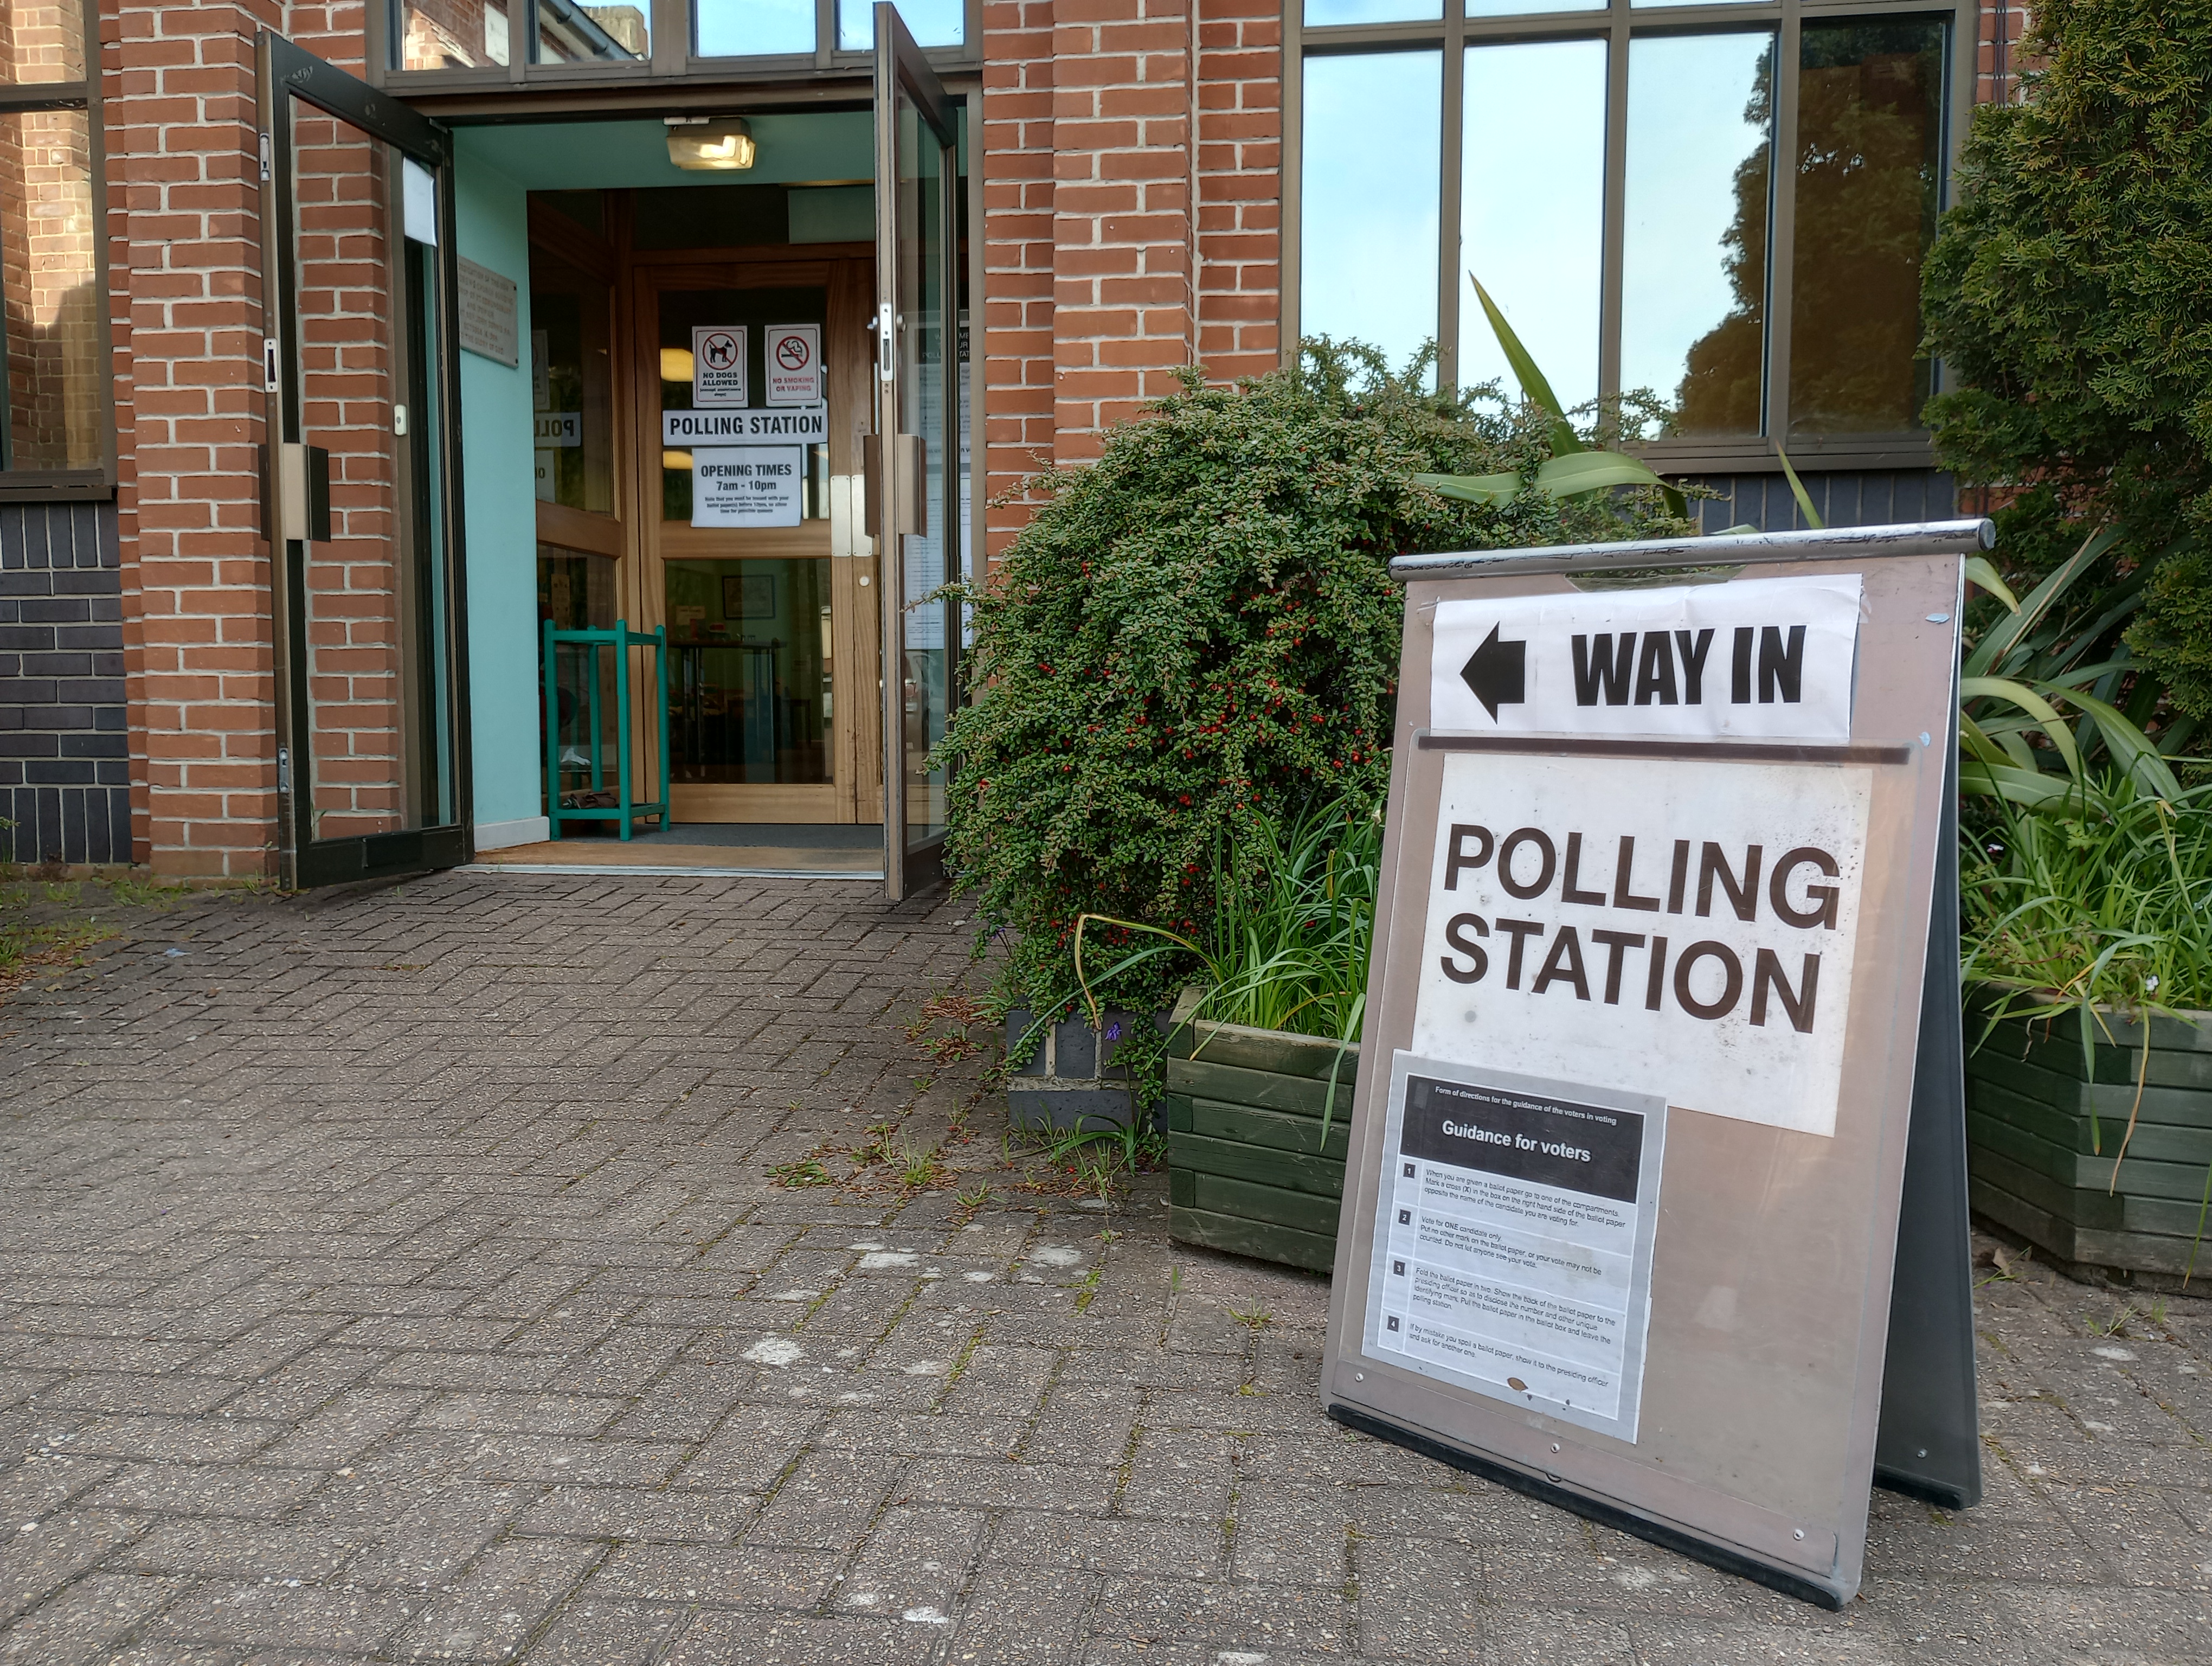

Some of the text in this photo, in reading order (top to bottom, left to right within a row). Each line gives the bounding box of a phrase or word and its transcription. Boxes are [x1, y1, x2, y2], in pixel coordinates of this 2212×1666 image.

[670, 415, 822, 435] POLLING STATION
[701, 464, 792, 477] OPENING TIMES
[716, 480, 738, 491] 7am
[748, 480, 776, 492] 10pm
[1571, 624, 1806, 707] WAY IN
[1443, 823, 1841, 931] POLLING
[1440, 913, 1821, 1034] STATION
[1435, 1086, 1451, 1094] Form
[1459, 1091, 1490, 1101] directions
[1513, 1101, 1542, 1111] guidance
[1564, 1110, 1585, 1118] voters
[1594, 1116, 1616, 1125] voting
[1442, 1120, 1590, 1162] Guidance for voters
[1425, 1177, 1439, 1186] Mark
[1462, 1186, 1471, 1194] (X)
[1490, 1191, 1501, 1200] box
[1536, 1202, 1552, 1211] hand
[1587, 1213, 1604, 1223] ballot
[1605, 1219, 1625, 1227] paper
[1489, 1182, 1505, 1191] ballot
[1401, 1213, 1407, 1221] 2
[1422, 1215, 1435, 1224] Vote
[1444, 1221, 1458, 1230] ONE
[1459, 1226, 1487, 1237] candidate
[1459, 1195, 1476, 1203] name
[1495, 1203, 1523, 1214] candidate
[1549, 1216, 1567, 1226] voting
[1420, 1224, 1430, 1232] Put
[1490, 1241, 1506, 1251] ballot
[1551, 1258, 1565, 1266] vote
[1566, 1261, 1580, 1271] may
[1593, 1267, 1602, 1275] be
[1472, 1248, 1494, 1257] anyone
[1412, 1294, 1431, 1305] polling
[1416, 1267, 1428, 1276] Fold
[1439, 1273, 1455, 1283] ballot
[1456, 1279, 1473, 1287] paper
[1558, 1305, 1576, 1315] ballot
[1577, 1311, 1596, 1320] paper
[1605, 1317, 1616, 1326] the
[1460, 1297, 1471, 1305] Put
[1482, 1303, 1498, 1313] ballot
[1499, 1309, 1517, 1318] paper
[1536, 1318, 1553, 1328] ballot
[1554, 1323, 1566, 1331] box
[1567, 1328, 1580, 1336] and
[1581, 1330, 1599, 1341] leave
[1600, 1335, 1611, 1344] the
[1509, 1301, 1519, 1309] the
[1520, 1305, 1544, 1315] number
[1558, 1316, 1574, 1324] other
[1414, 1324, 1422, 1334] by
[1458, 1338, 1471, 1347] spoil
[1477, 1343, 1494, 1354] ballot
[1515, 1355, 1532, 1364] show
[1546, 1363, 1556, 1372] the
[1441, 1343, 1463, 1353] another
